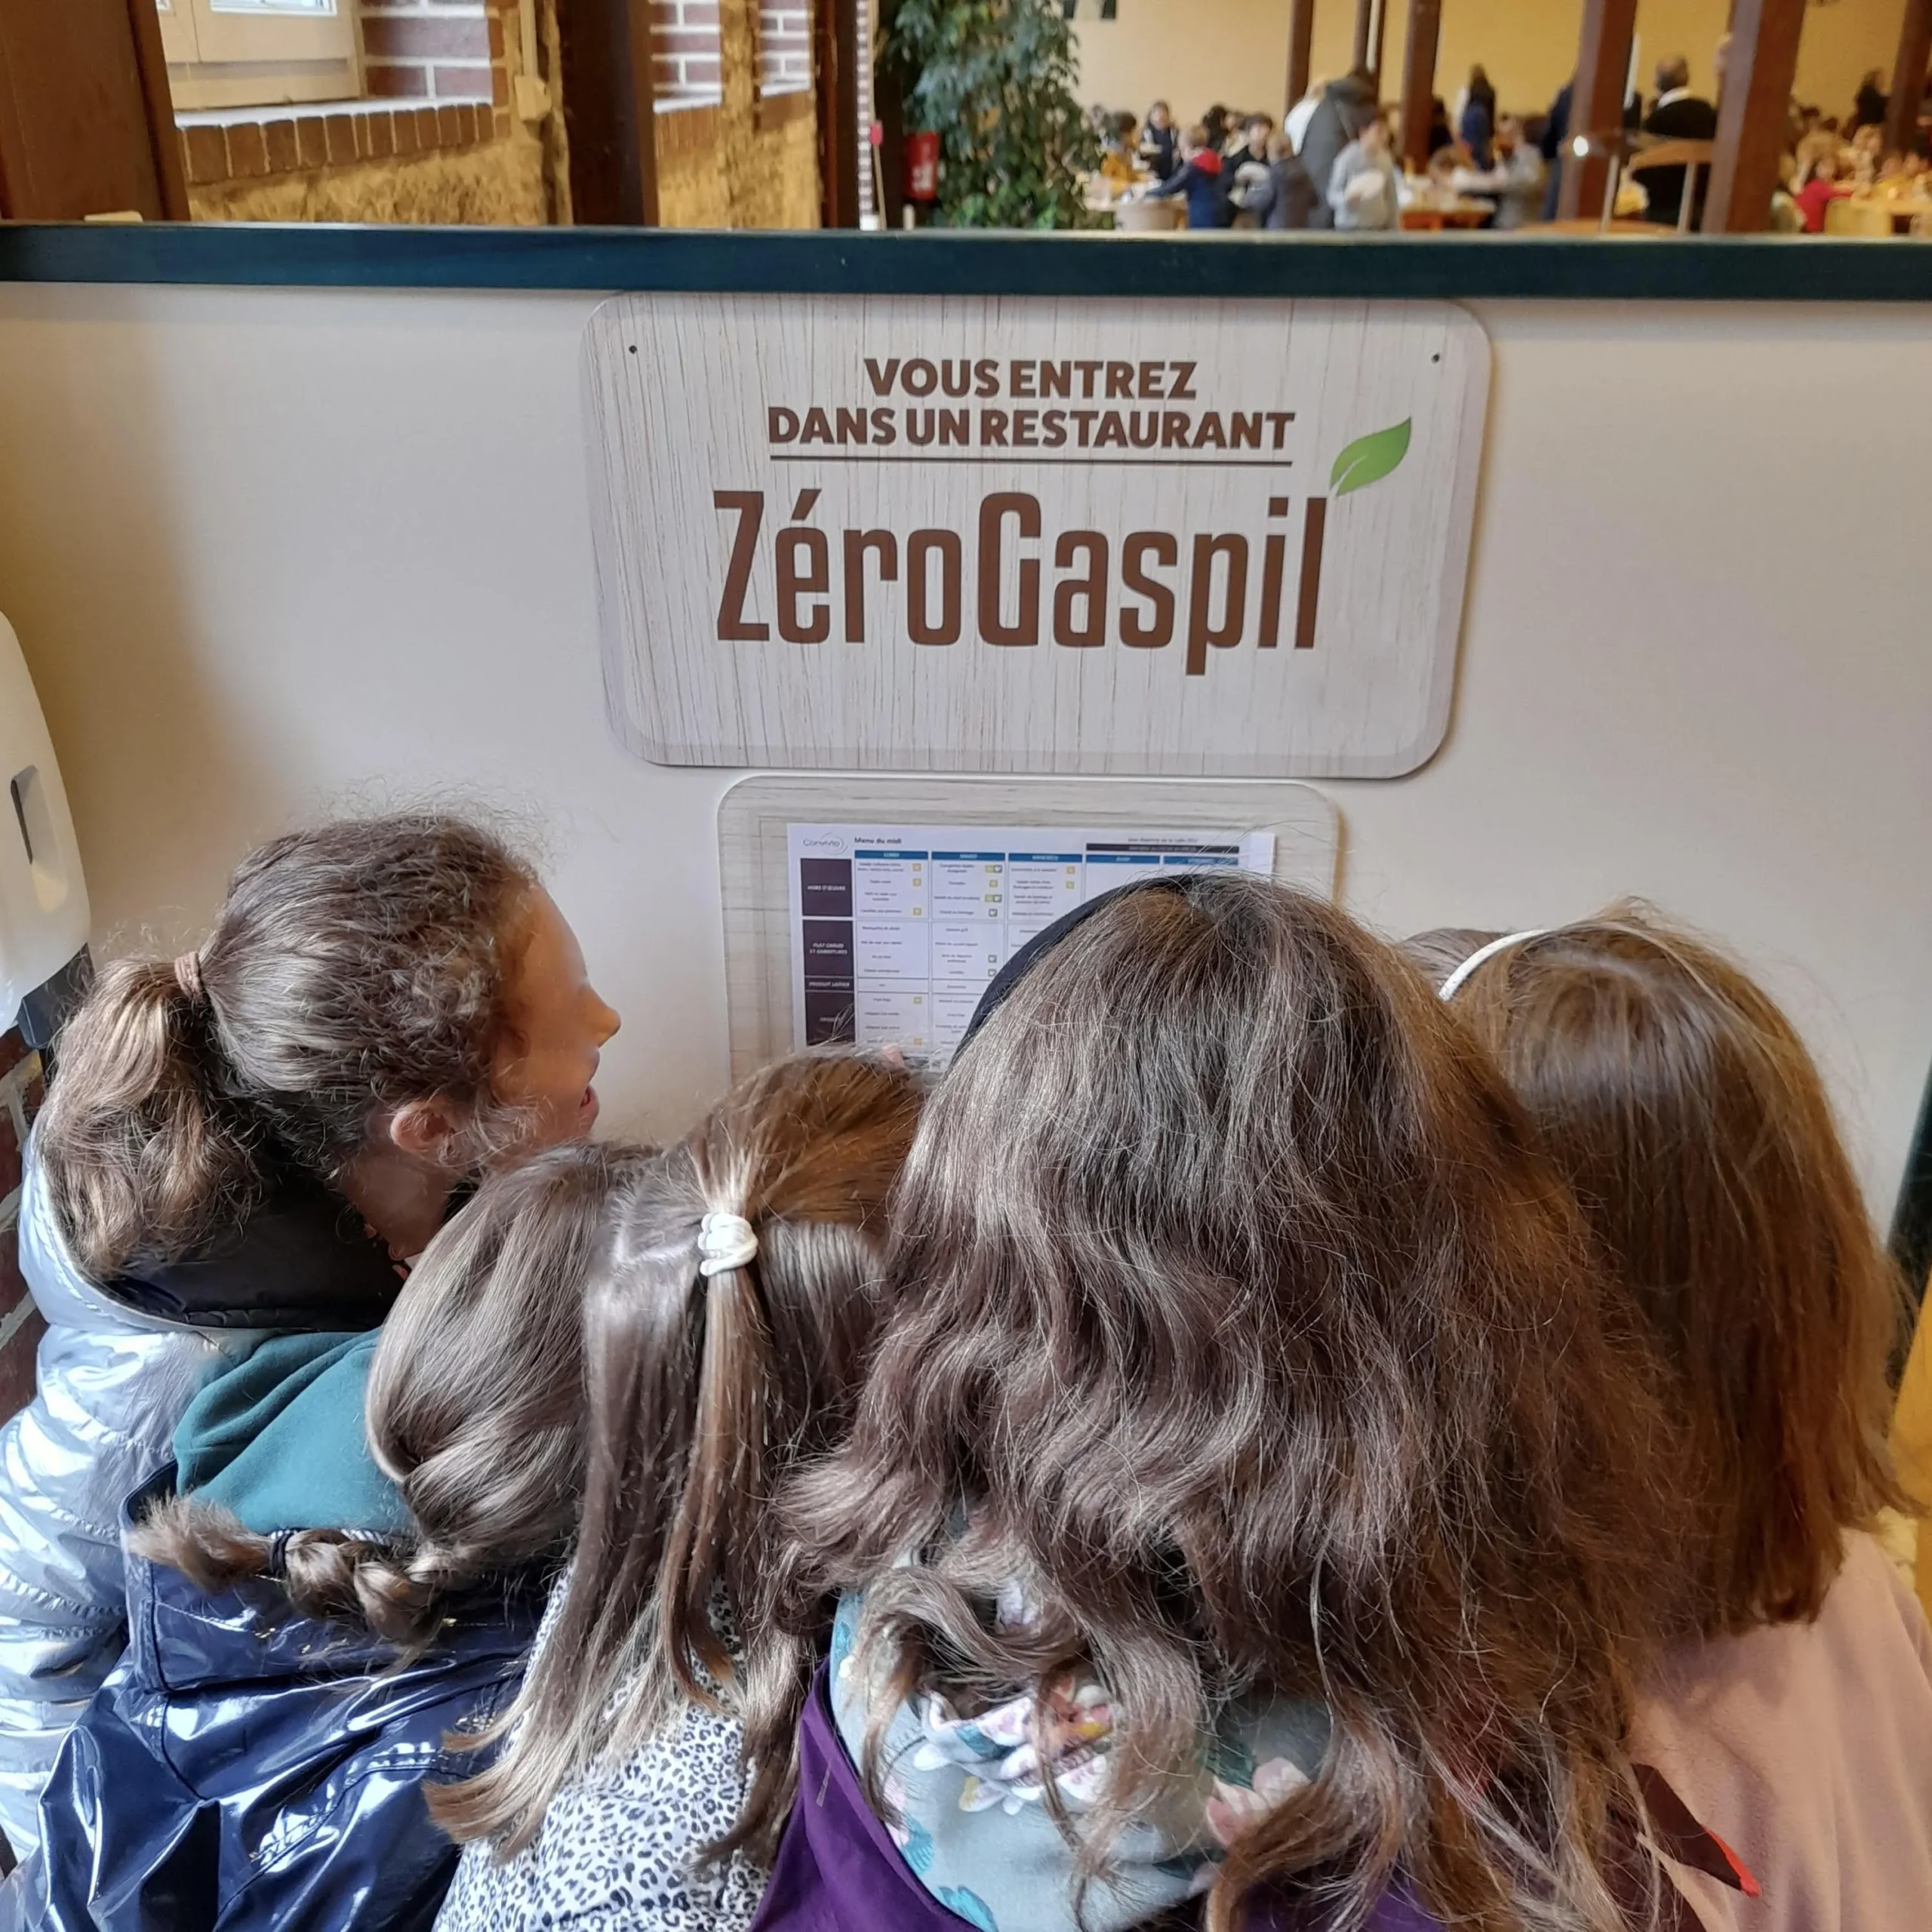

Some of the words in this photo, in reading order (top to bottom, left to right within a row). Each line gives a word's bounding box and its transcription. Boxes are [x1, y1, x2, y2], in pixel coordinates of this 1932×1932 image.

[863, 358, 1000, 398] VOUS
[1010, 360, 1198, 400] ENTREZ
[768, 406, 897, 445] DANS
[906, 408, 970, 447] UN
[980, 408, 1296, 451] RESTAURANT
[712, 488, 1327, 676] ZéroGaspil
